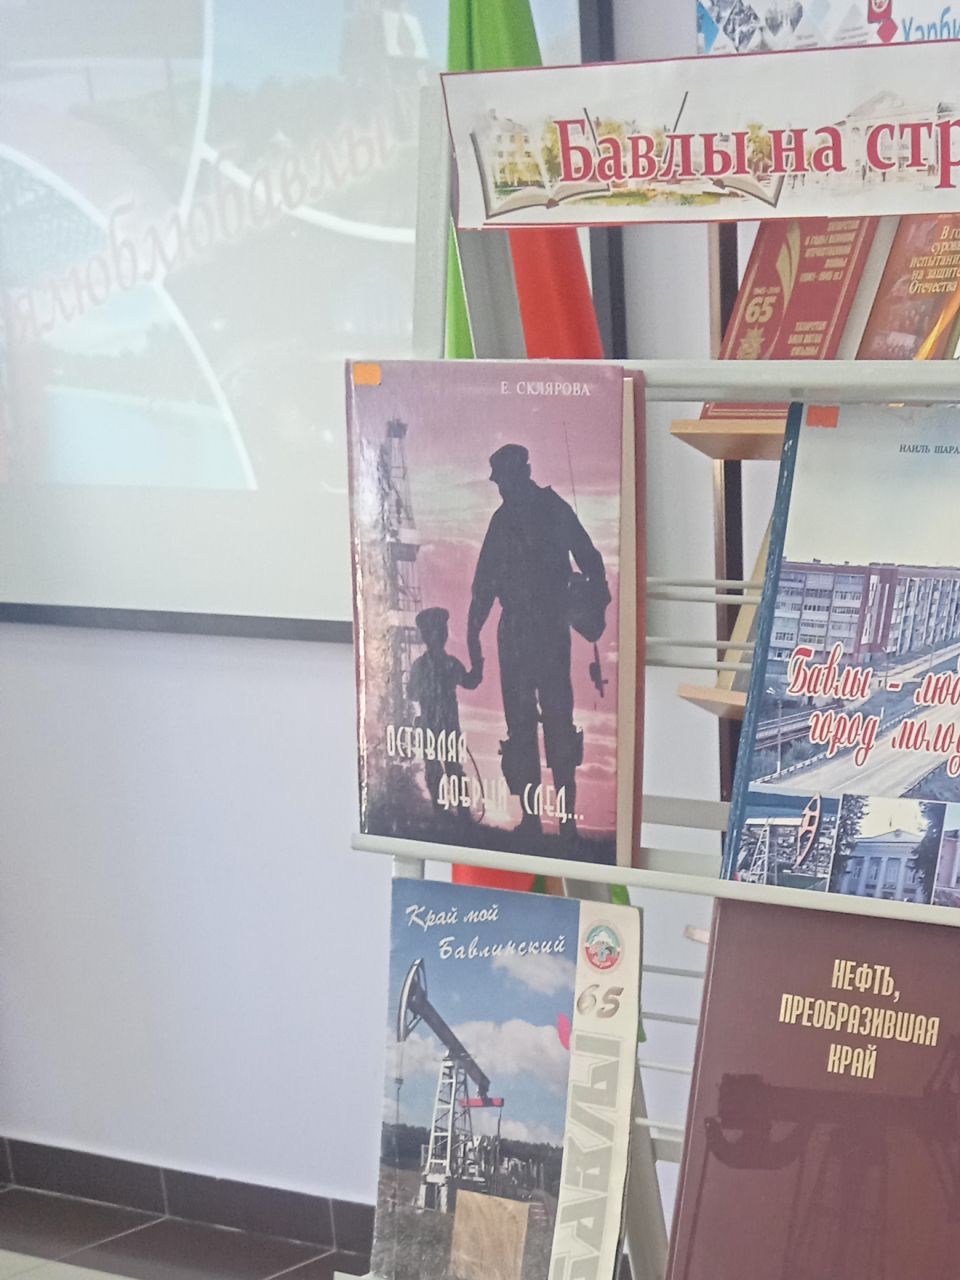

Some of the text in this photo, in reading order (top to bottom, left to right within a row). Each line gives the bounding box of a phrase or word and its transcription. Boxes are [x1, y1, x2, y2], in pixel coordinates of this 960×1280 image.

[554, 118, 748, 184] Бавлы
[768, 127, 845, 174] на
[745, 295, 776, 323] 65
[500, 381, 591, 397] Е. СКЛЯРОВА
[899, 443, 931, 454] НАИЛЬ
[787, 642, 872, 700] Бавлы
[808, 704, 877, 766] город
[405, 903, 500, 927] Край мой
[438, 933, 566, 961] Бавлинский
[831, 959, 901, 1002] НЕФТЬ,
[577, 984, 624, 1018] 65
[778, 993, 941, 1047] ПРЕОБРАЗИВШАЯ
[826, 1043, 878, 1079] КРАЙ
